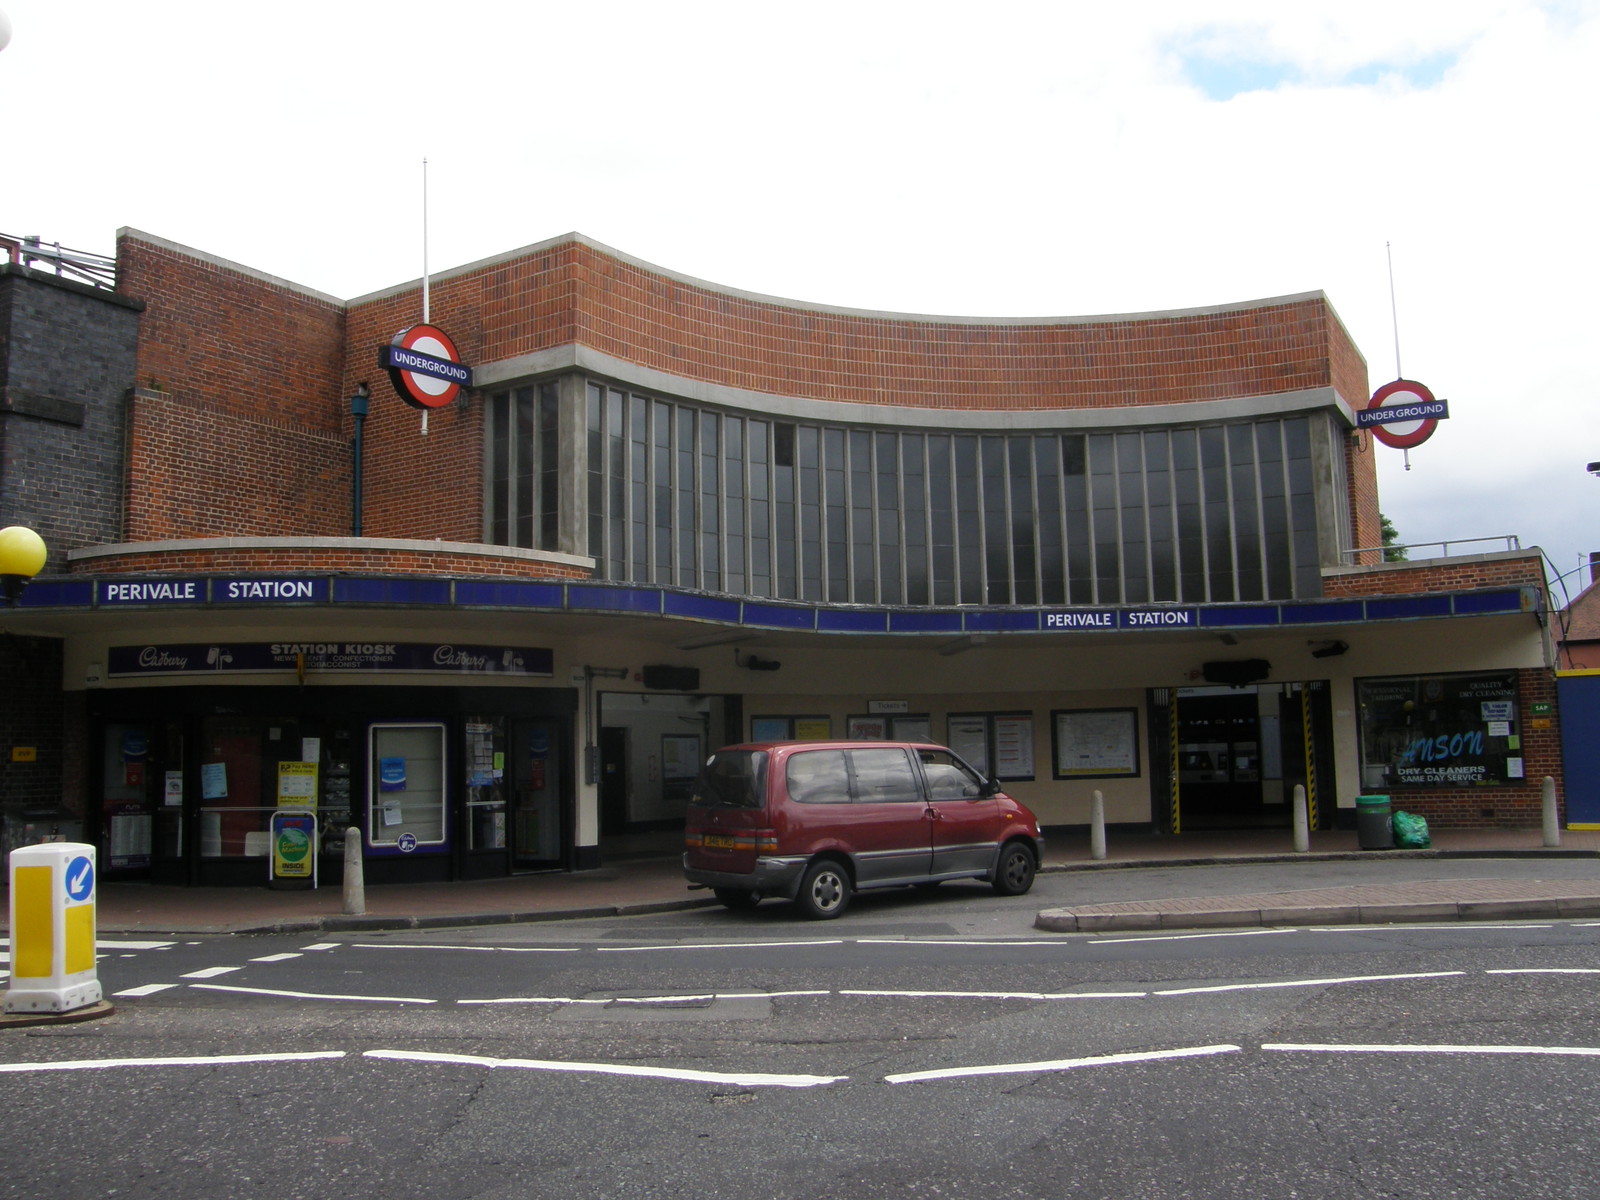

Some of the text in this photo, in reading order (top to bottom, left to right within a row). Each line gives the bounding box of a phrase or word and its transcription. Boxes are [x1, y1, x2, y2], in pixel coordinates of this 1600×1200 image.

[394, 351, 467, 380] UNDERGROUND
[1360, 404, 1444, 422] UNDERGROUND
[107, 581, 313, 601] PERIVALE STATION
[1047, 611, 1189, 627] PERIVALE STATION
[138, 646, 188, 669] Cadbury
[270, 643, 397, 655] STATION KIOSK
[433, 645, 488, 669] Cadbury
[1469, 681, 1503, 690] QUALITY
[1475, 688, 1516, 697] CLEANING
[1399, 729, 1484, 766] ANSON
[1397, 766, 1486, 776] DRY CLEANERS
[1401, 773, 1483, 783] SAME DAY SERVICE
